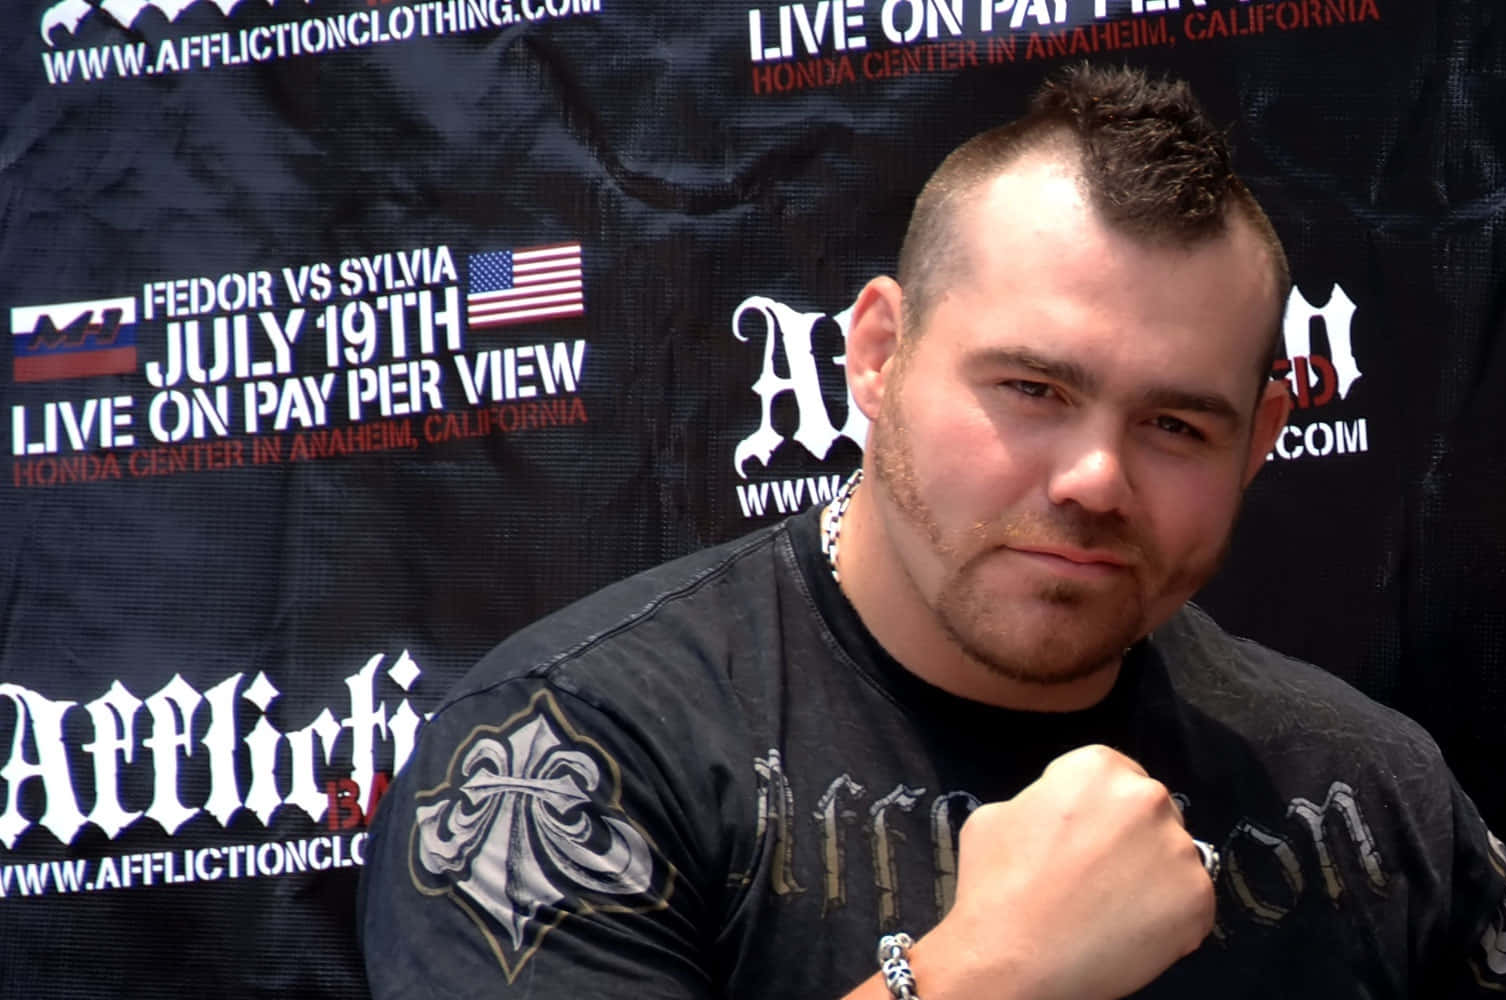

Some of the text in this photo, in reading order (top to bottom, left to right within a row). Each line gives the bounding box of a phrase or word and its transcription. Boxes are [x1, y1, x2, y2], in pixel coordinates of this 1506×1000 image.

[748, 2, 867, 62] LIVE
[881, 0, 962, 43] ON
[751, 62, 856, 95] HONDA
[863, 46, 979, 81] CENTER
[987, 38, 1017, 64] IN
[1025, 24, 1177, 59] ANAHEIM,
[1185, 0, 1379, 41] CALIFORNIA
[143, 245, 457, 320] FEDOR VS SYLVIA
[145, 286, 462, 387] JULY 19TH
[12, 340, 586, 456] LIVE ON PAY PER VIEW
[12, 397, 588, 487] HONDA CENTER IN ANAHEIM, CALIFORNIA
